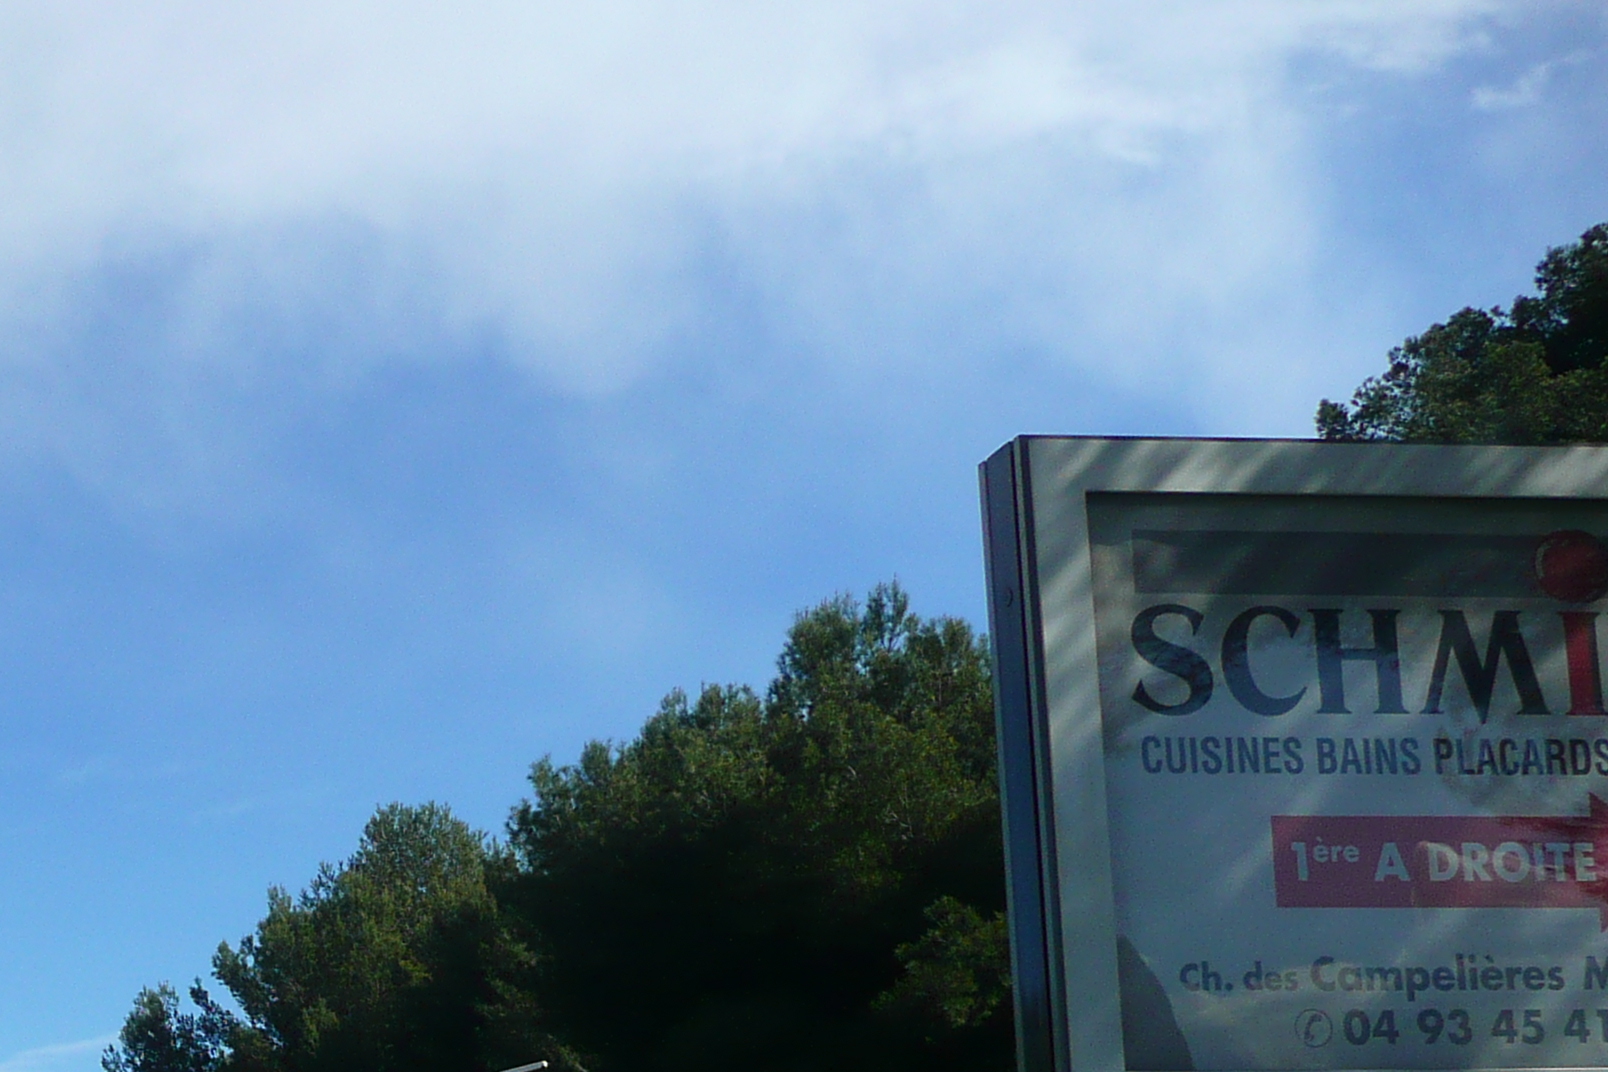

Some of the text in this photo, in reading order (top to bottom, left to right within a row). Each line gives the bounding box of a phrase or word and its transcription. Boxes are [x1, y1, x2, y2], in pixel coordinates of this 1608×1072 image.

[1142, 735, 1608, 777] CUISINES BAINS PLACARDS
[1292, 836, 1598, 883] 1ère A DROITE
[1179, 960, 1234, 991] Ch.
[1242, 960, 1300, 992] des
[1309, 953, 1566, 1002] Campelières
[1343, 1008, 1400, 1046] 04
[1416, 1008, 1473, 1046] 93
[1491, 1008, 1545, 1046] 45
